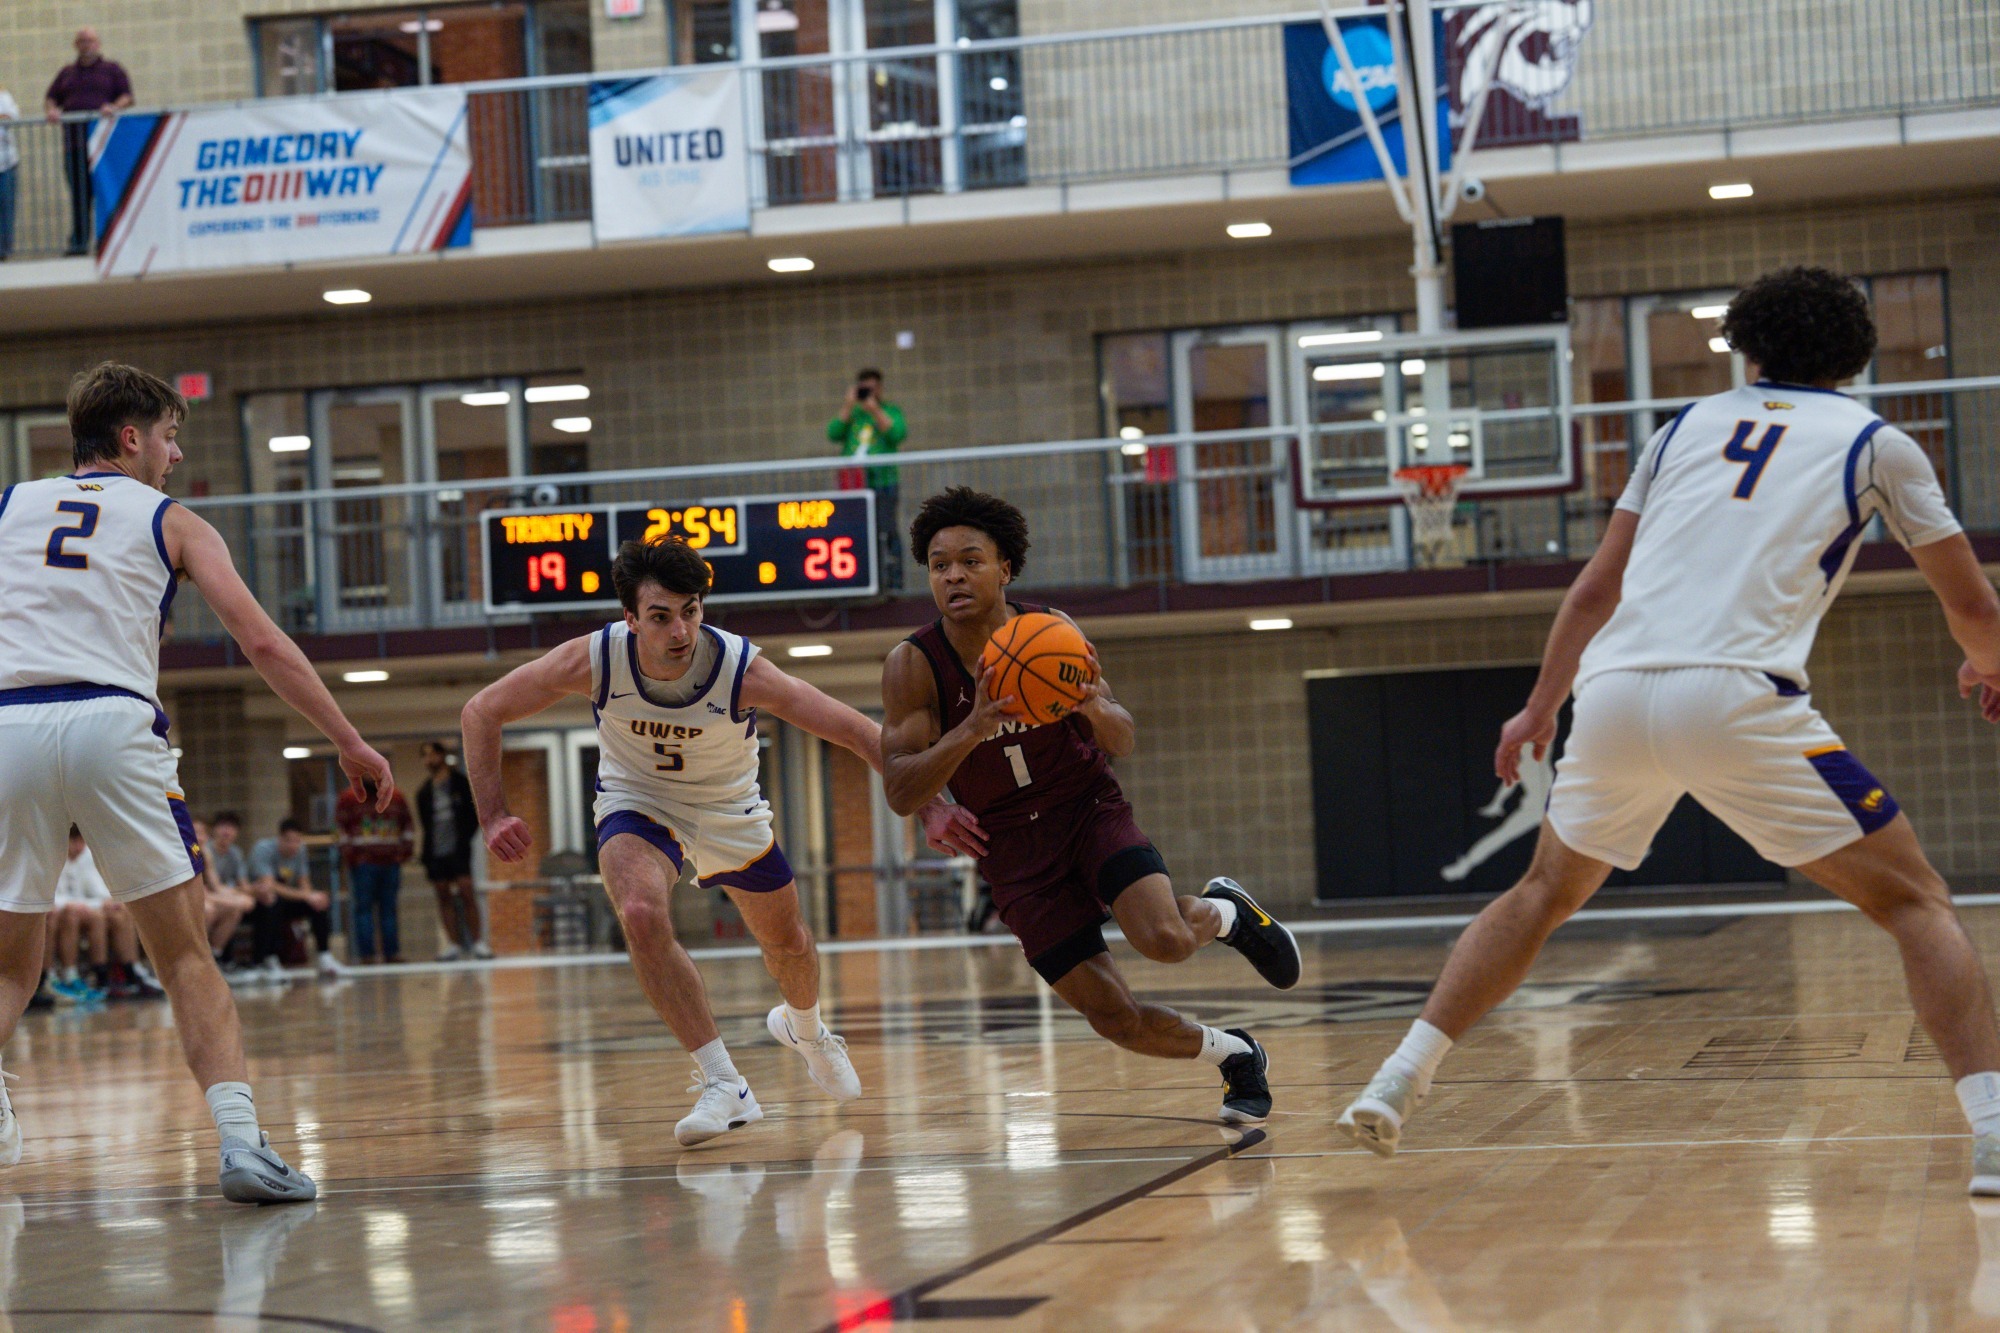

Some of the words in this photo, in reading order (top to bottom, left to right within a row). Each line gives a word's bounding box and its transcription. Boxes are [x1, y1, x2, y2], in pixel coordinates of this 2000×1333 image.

[196, 128, 363, 172] GAMEDAY
[614, 128, 723, 167] UNITED
[1721, 419, 1789, 502] 4
[44, 500, 101, 570] 2
[501, 512, 593, 544] TRINITY
[644, 506, 737, 549] 2:54
[528, 551, 567, 592] 19
[804, 536, 857, 581] 26
[1058, 661, 1090, 688] Wil
[630, 720, 703, 740] UWSP
[653, 742, 685, 772] 5
[1003, 743, 1032, 788] 1
